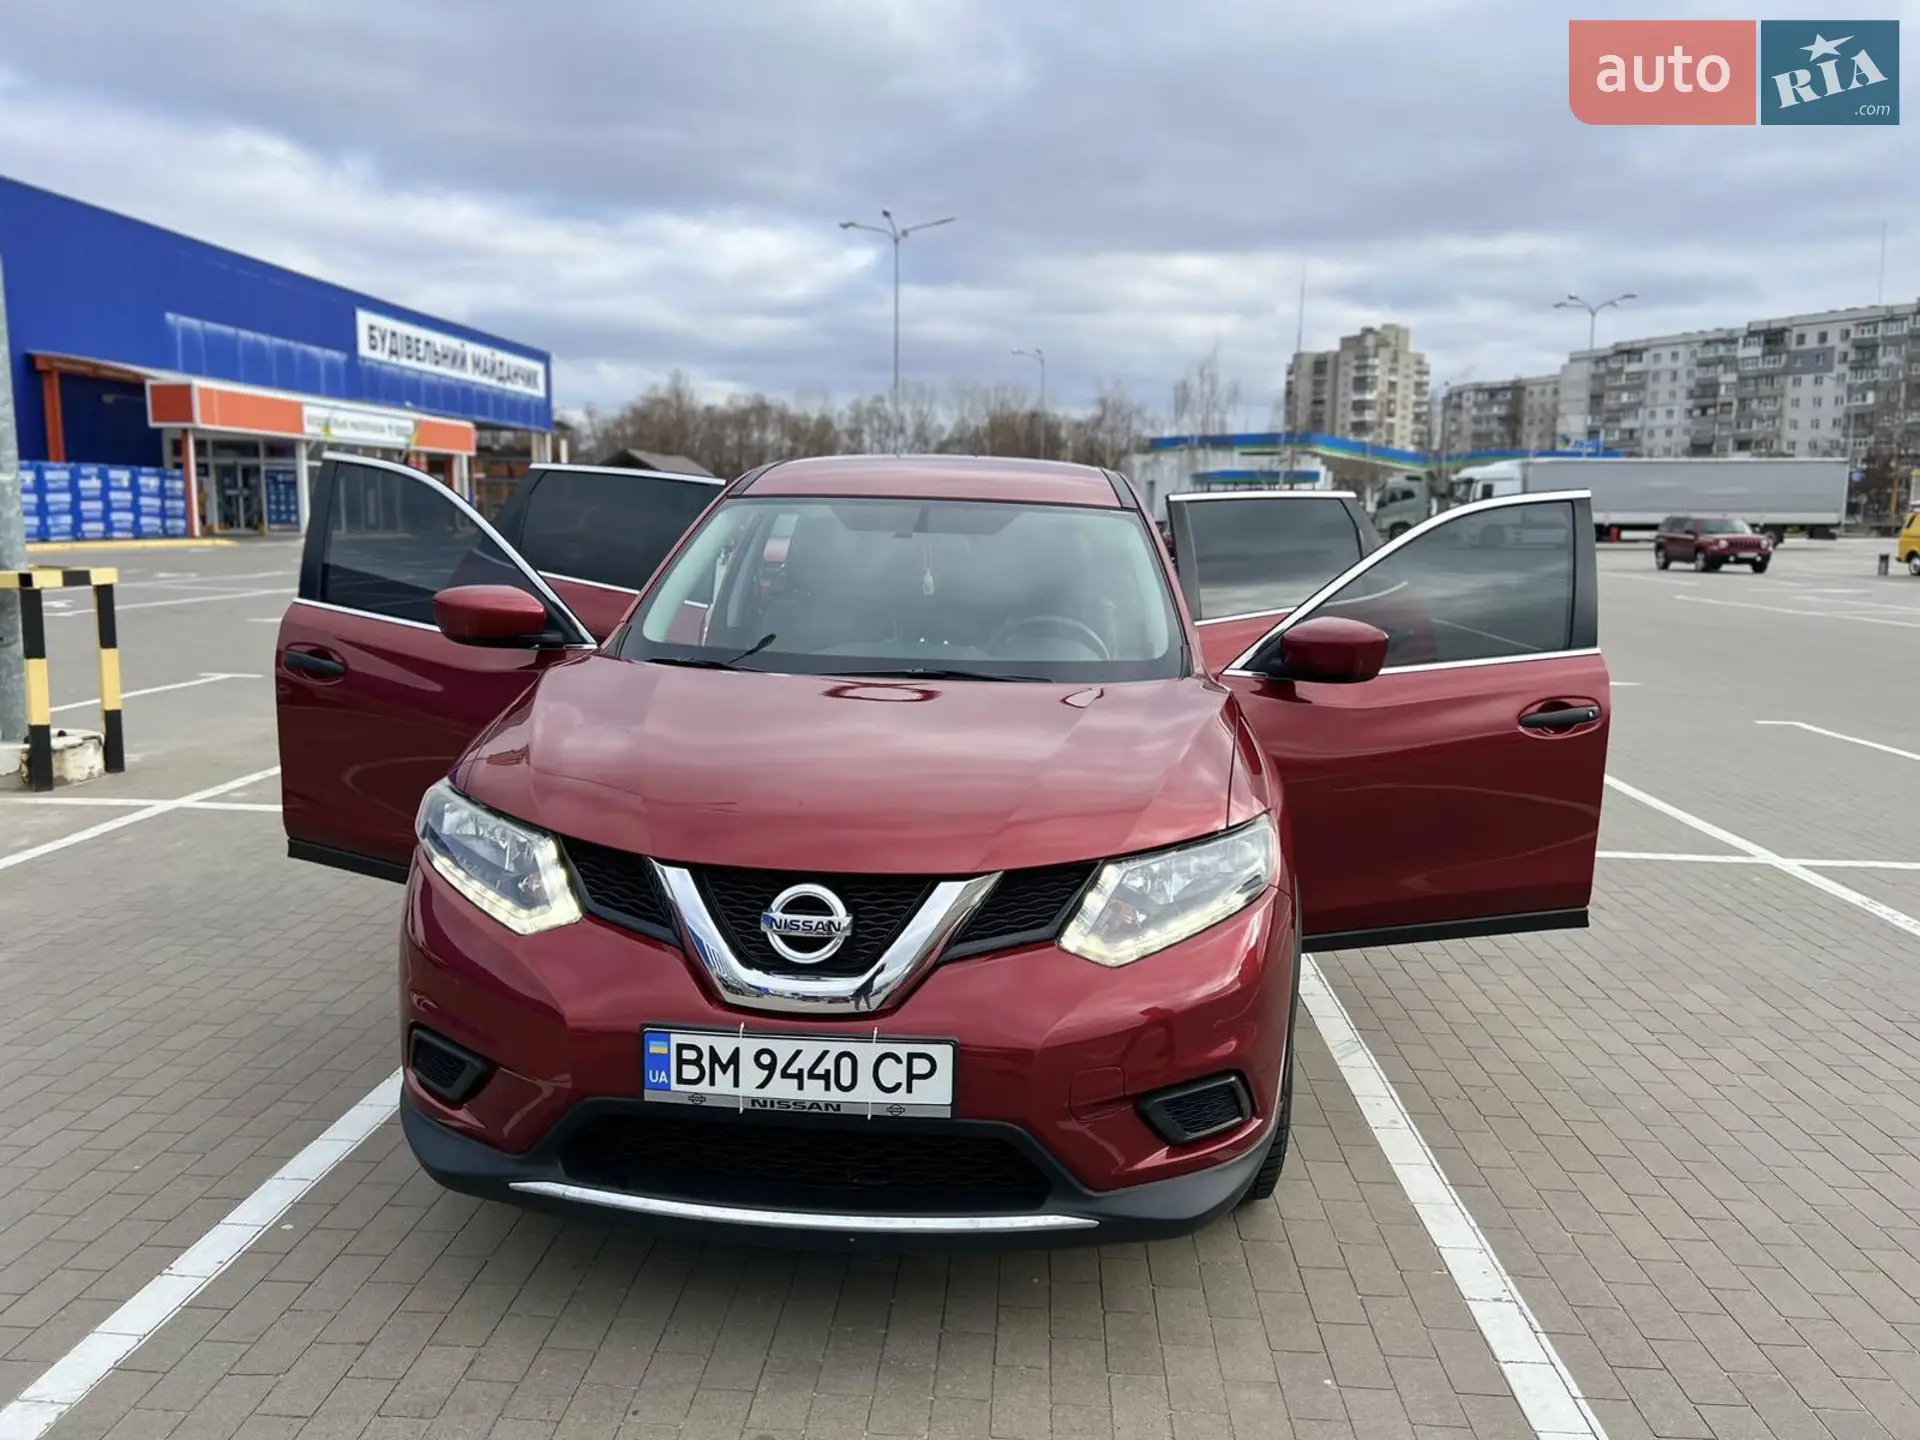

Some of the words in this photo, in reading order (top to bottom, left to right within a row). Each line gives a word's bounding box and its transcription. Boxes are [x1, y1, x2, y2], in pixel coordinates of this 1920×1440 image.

[367, 323, 468, 373] БУДІВЕЛЬНИЙ
[470, 351, 540, 390] МАЙДАНЧИК
[770, 917, 842, 932] NISSAN
[675, 1042, 741, 1088] BM
[753, 1047, 859, 1093] 9440
[872, 1051, 938, 1094] CP
[649, 1069, 669, 1084] UA
[750, 1098, 843, 1113] NISSAN
